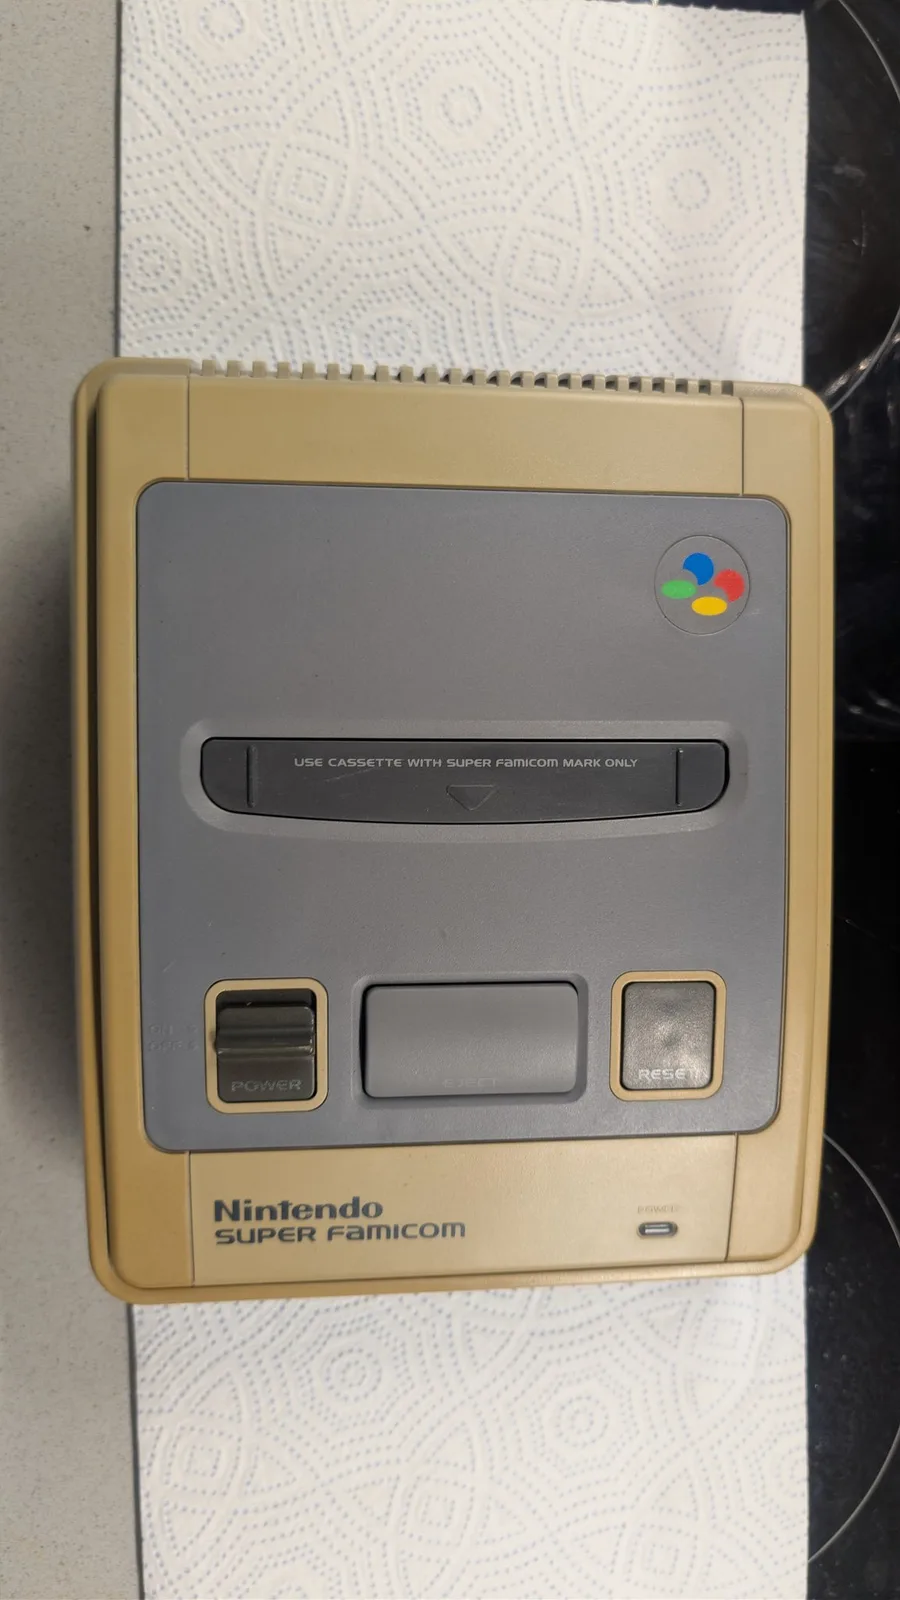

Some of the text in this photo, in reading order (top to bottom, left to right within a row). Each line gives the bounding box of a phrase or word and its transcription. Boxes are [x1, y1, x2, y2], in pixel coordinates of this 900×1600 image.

[294, 758, 323, 767] USE
[328, 758, 403, 768] CASSETTE
[407, 758, 442, 768] WITH
[446, 758, 492, 768] SUPER
[562, 758, 601, 768] MARK
[604, 758, 638, 768] ONLY
[231, 1079, 302, 1092] POWER
[213, 1196, 383, 1222] Nintendo
[215, 1226, 316, 1245] SUPER
